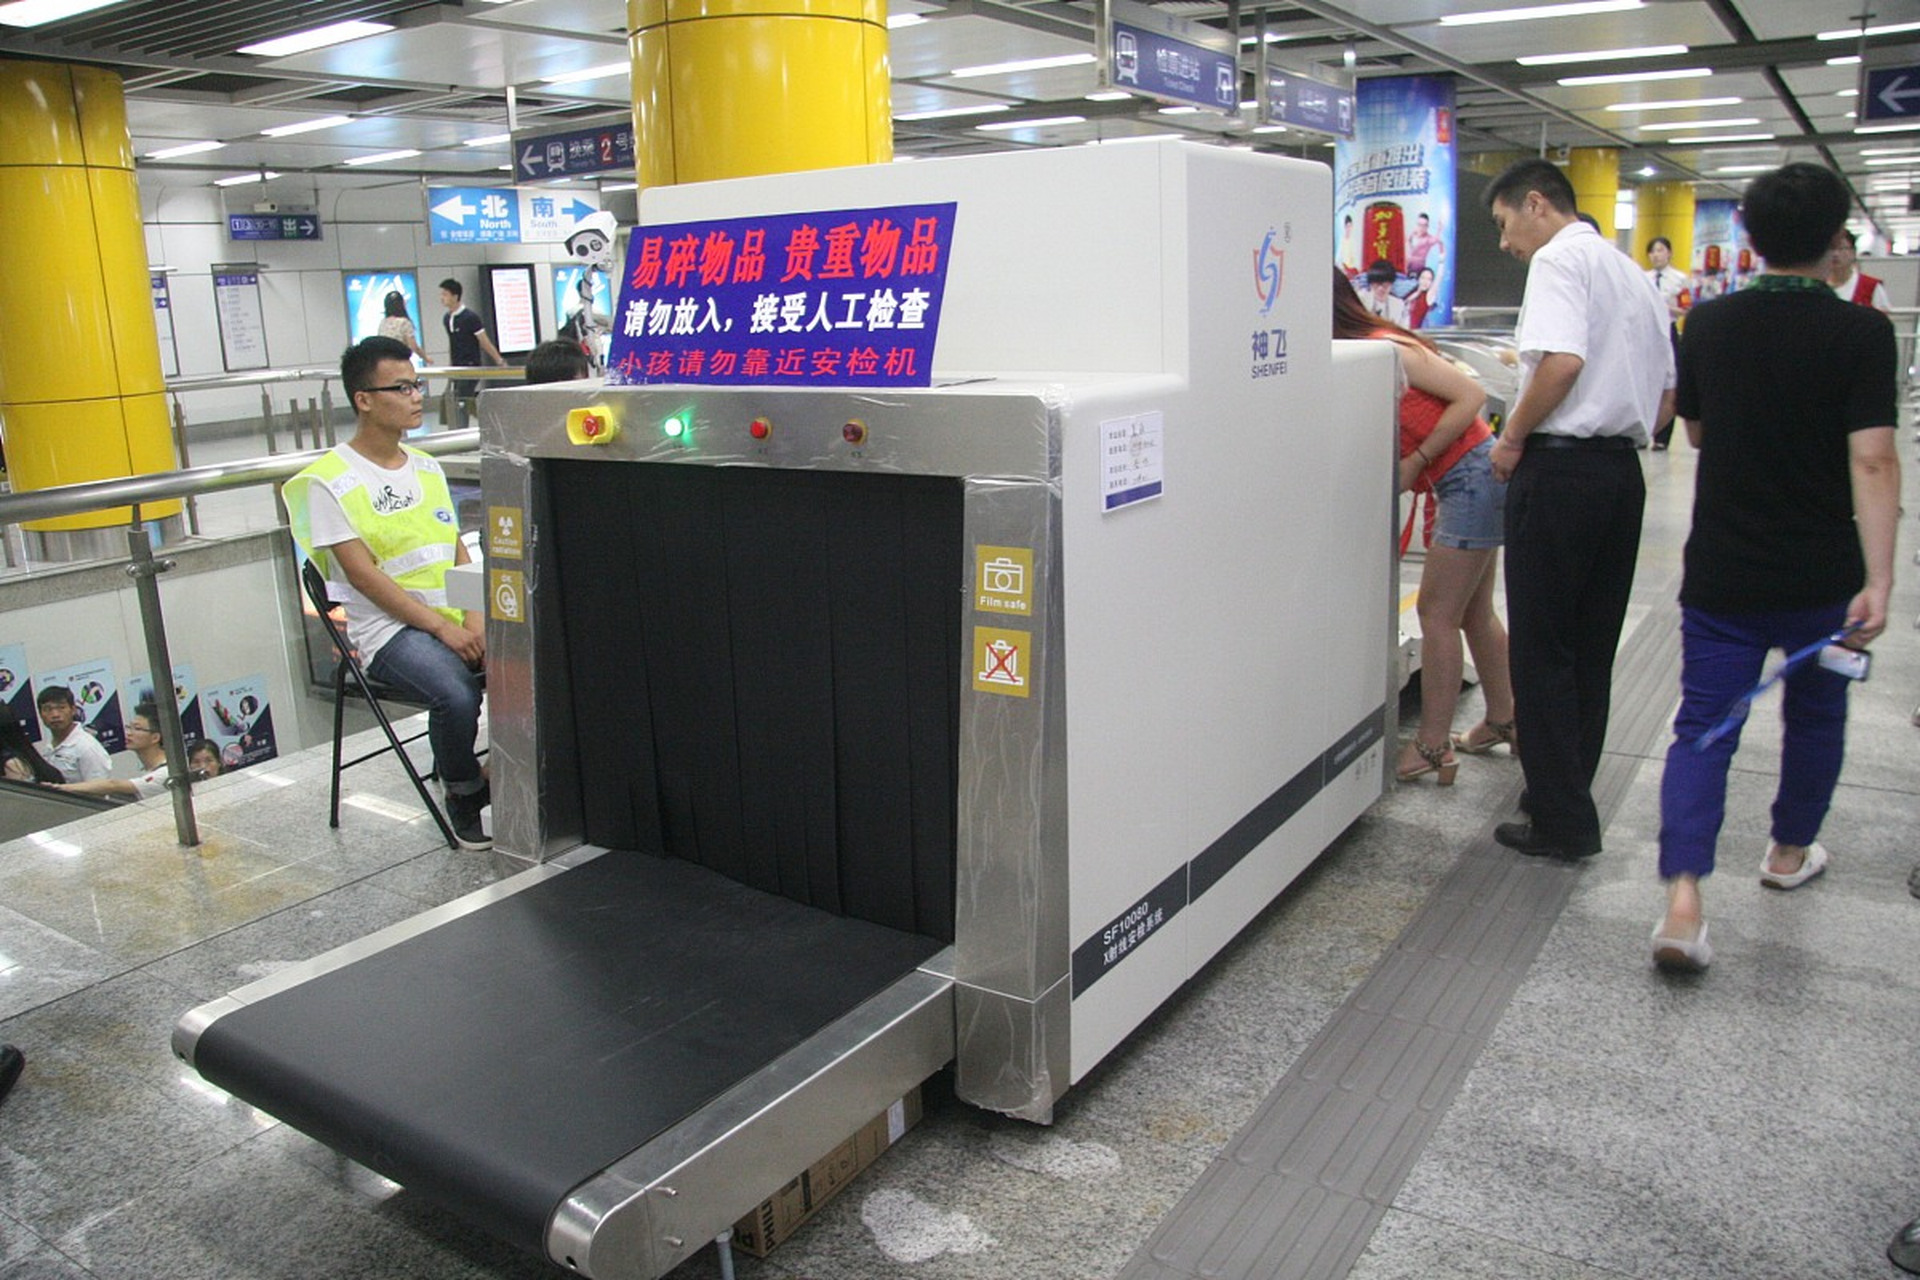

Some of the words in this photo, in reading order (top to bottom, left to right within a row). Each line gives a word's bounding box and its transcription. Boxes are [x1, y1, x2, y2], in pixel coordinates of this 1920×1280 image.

[480, 195, 509, 219] 北
[531, 197, 554, 218] 南
[480, 219, 511, 229] North
[631, 229, 766, 290] 易碎物品
[780, 217, 939, 284] 贵重物品
[1251, 328, 1287, 361] 神飞
[618, 346, 917, 377] 小孩请勿靠近安检机
[1251, 361, 1287, 379] SHENFEI
[980, 596, 1002, 607] Film
[1004, 599, 1027, 610] safe
